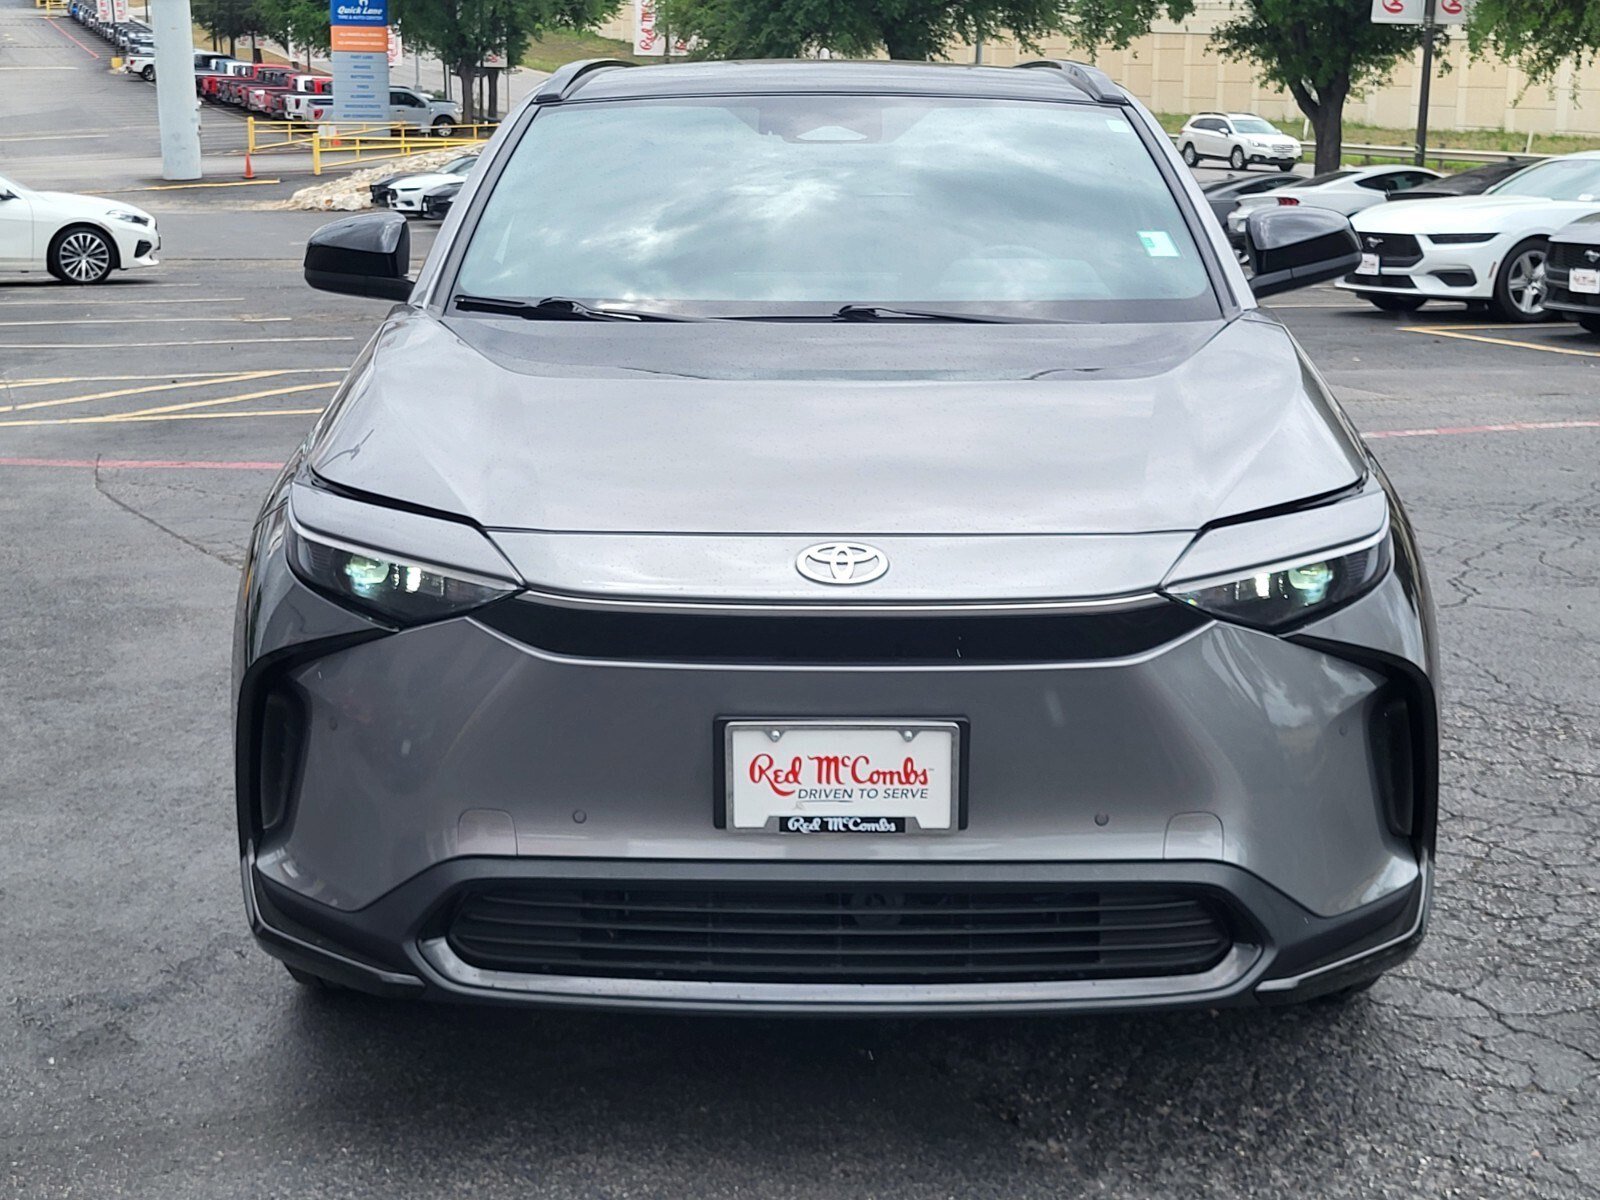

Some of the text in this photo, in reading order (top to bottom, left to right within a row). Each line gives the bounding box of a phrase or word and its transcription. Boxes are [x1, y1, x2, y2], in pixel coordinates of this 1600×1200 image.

[337, 5, 383, 15] Quick Lane
[640, 28, 657, 51] Red
[749, 753, 929, 797] Red McCombs
[797, 788, 929, 800] DRIVEN TO SERVE
[787, 816, 897, 833] Red McCombs
